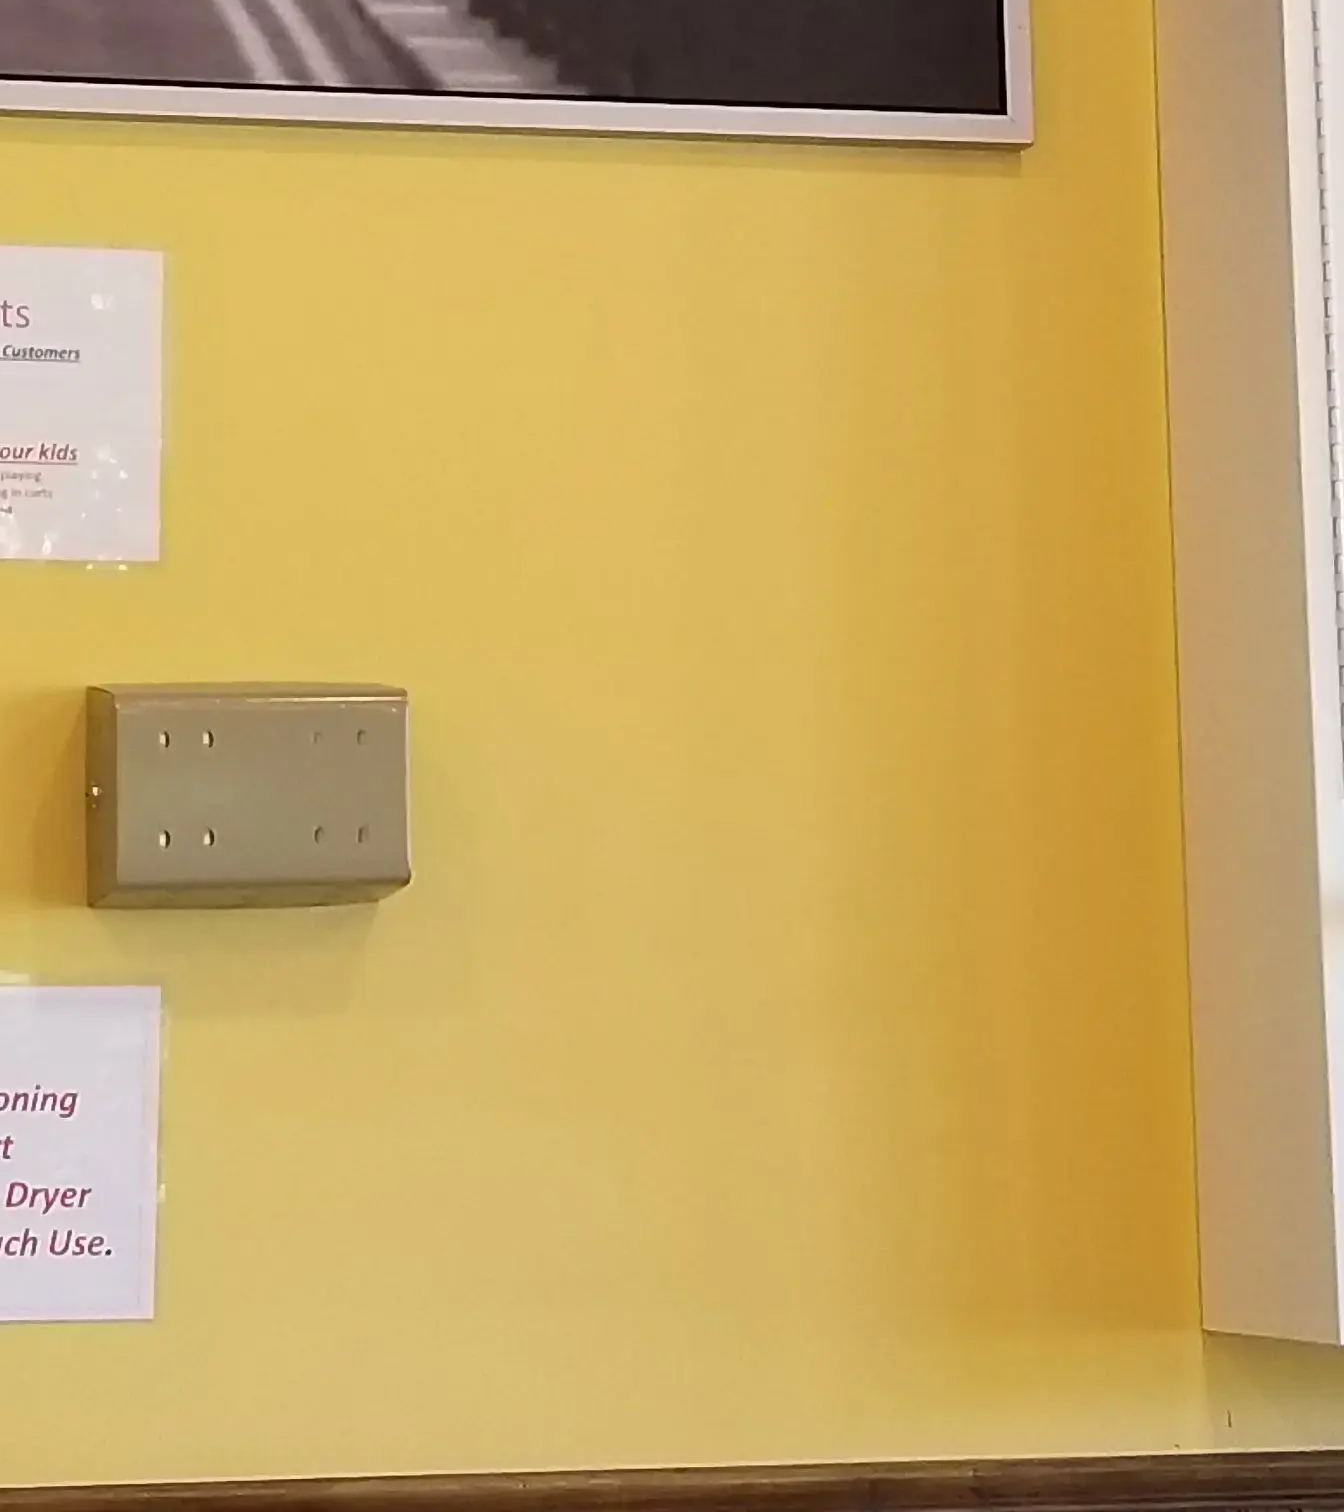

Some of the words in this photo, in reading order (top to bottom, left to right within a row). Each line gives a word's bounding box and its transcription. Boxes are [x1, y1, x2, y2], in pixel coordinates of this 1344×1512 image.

[3, 344, 81, 361] Customers
[38, 443, 79, 462] kids
[5, 1181, 92, 1215] Dryer
[48, 1229, 113, 1258] Use.
